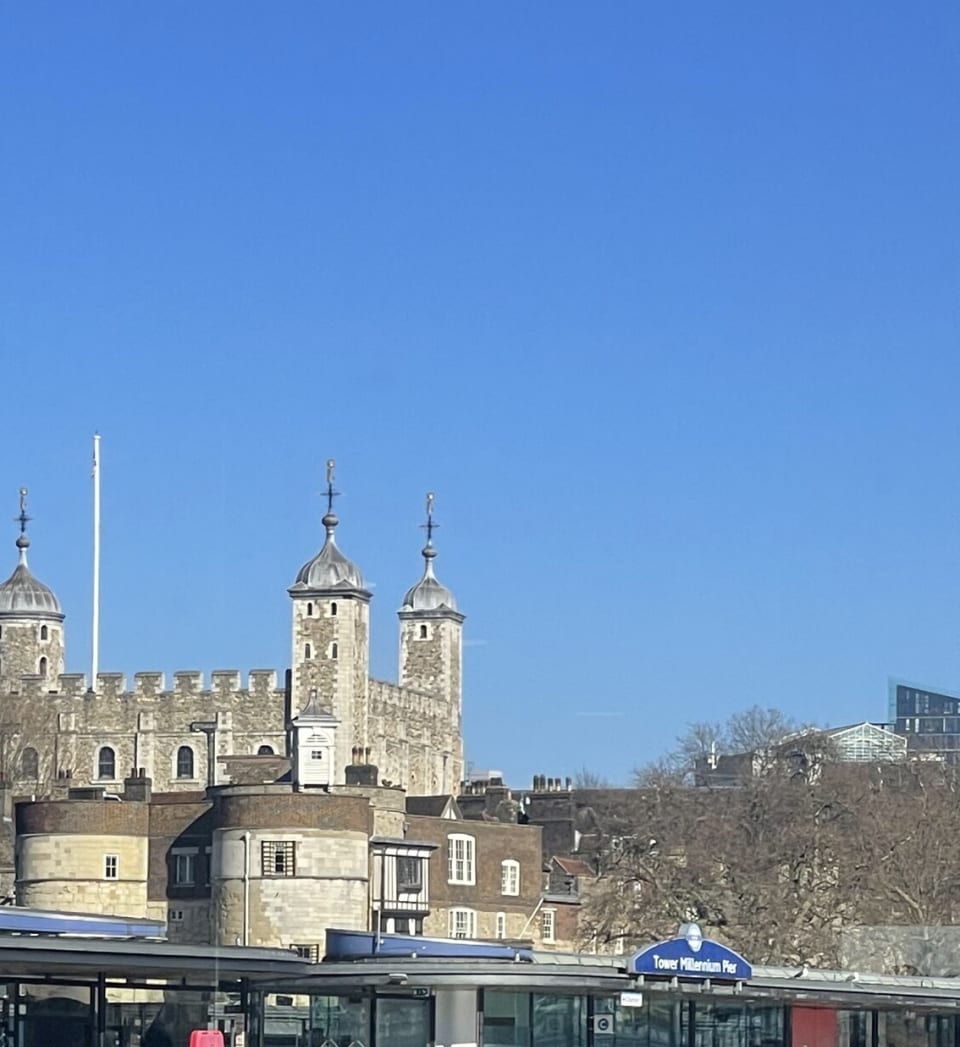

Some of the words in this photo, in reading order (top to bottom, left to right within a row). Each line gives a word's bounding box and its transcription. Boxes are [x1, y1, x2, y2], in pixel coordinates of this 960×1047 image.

[653, 955, 678, 970] Tower
[680, 957, 721, 973] Millennium
[722, 960, 737, 974] Pier
